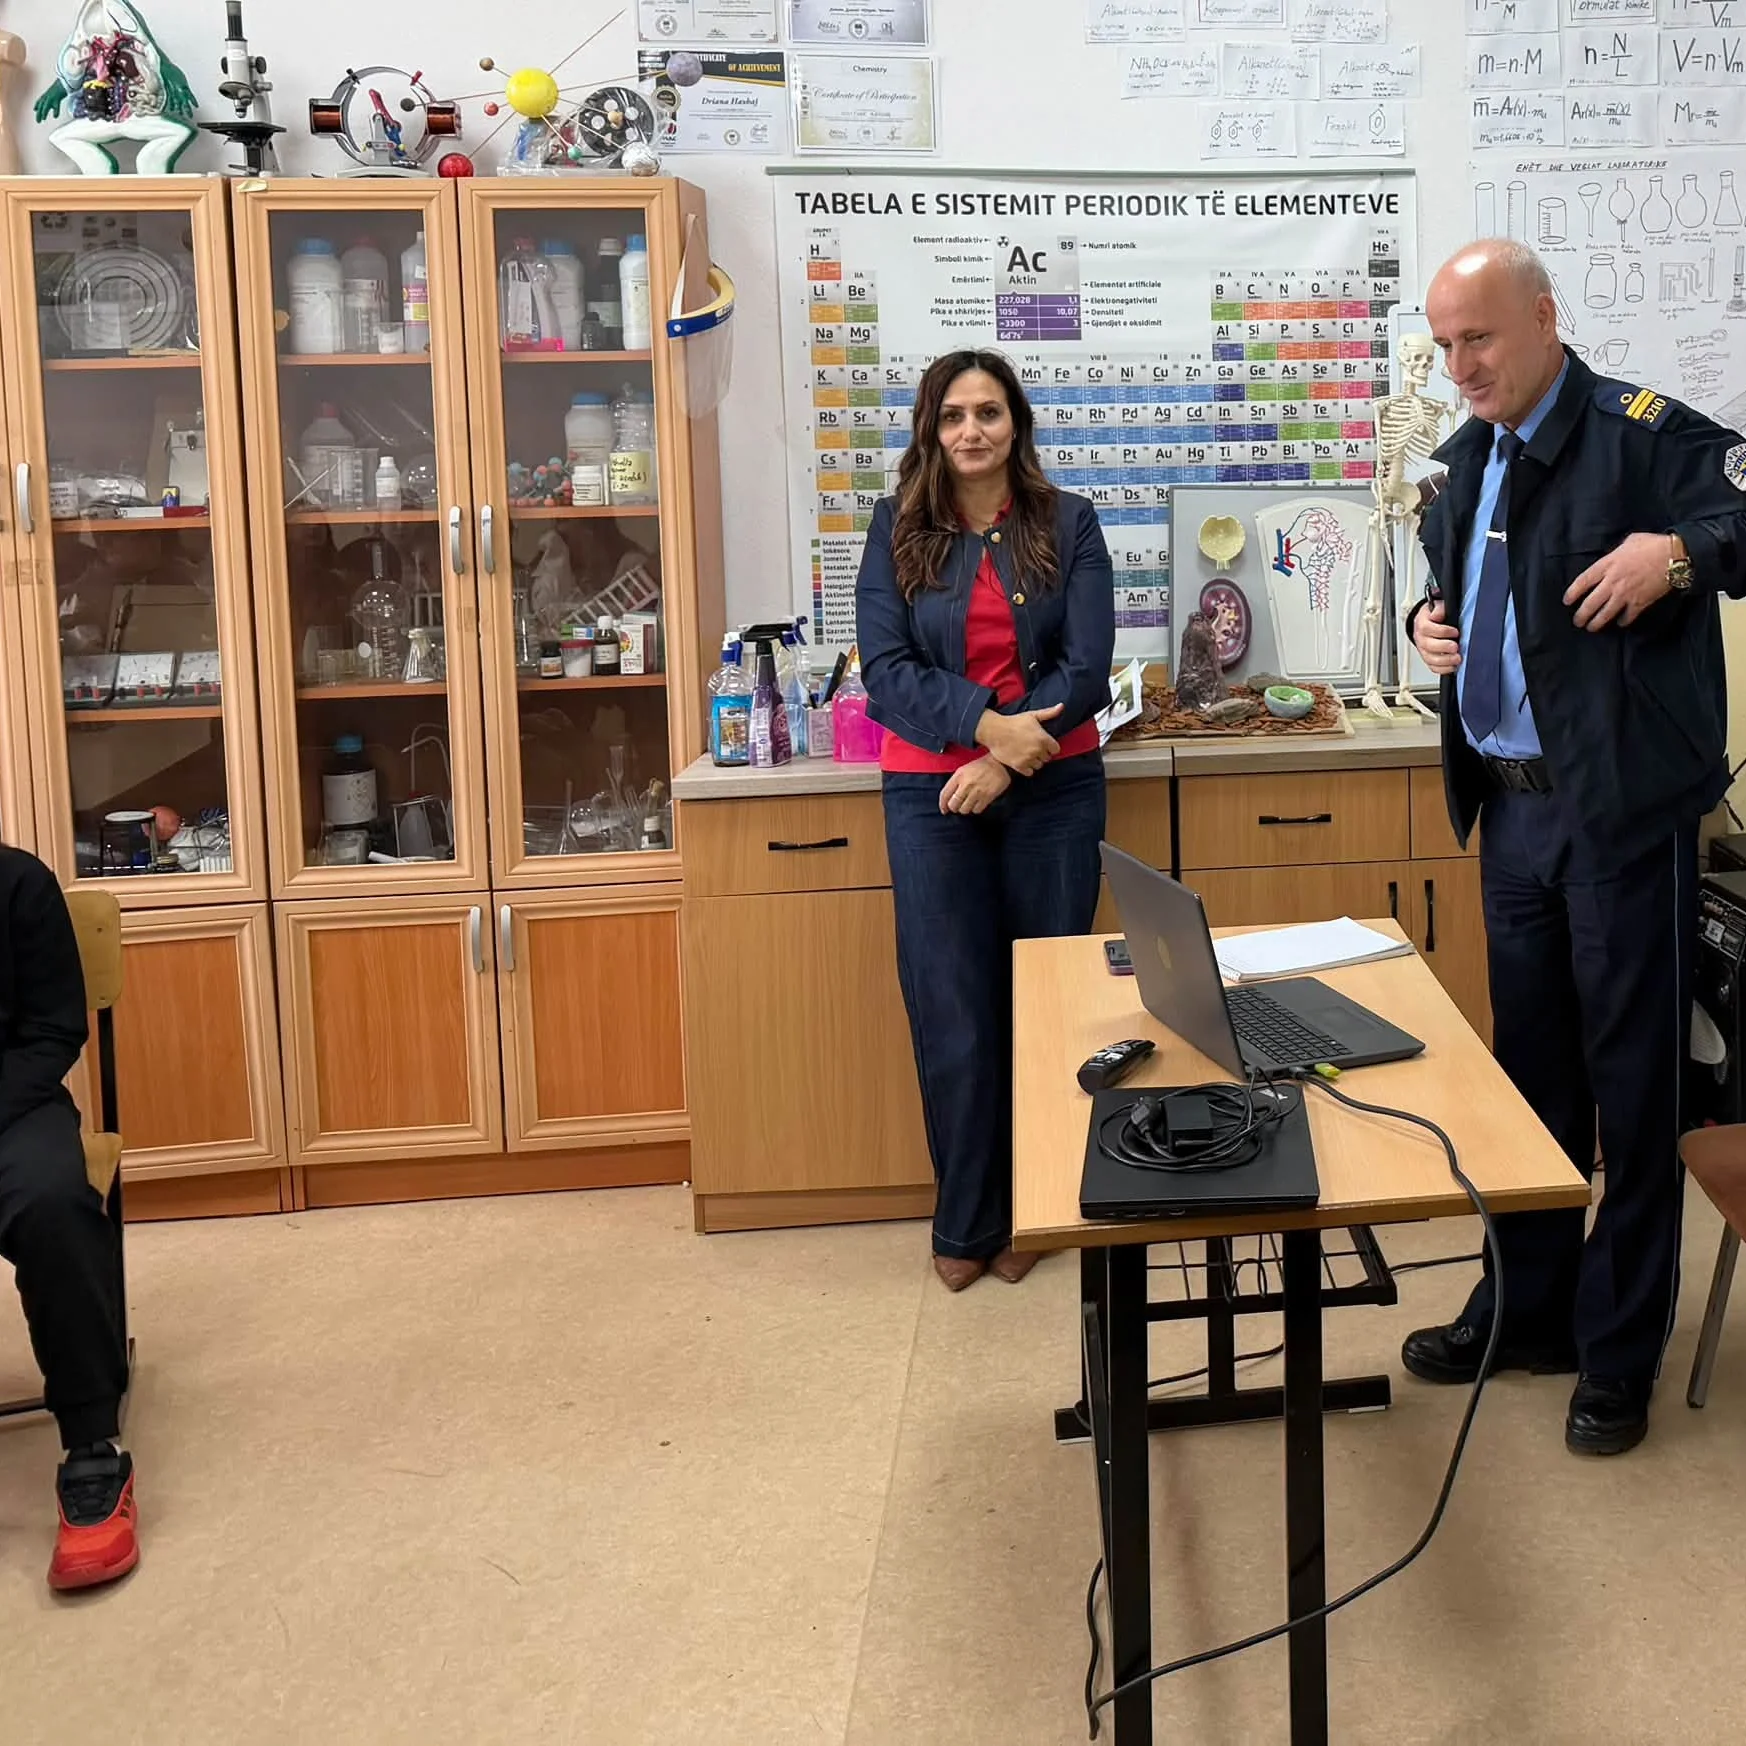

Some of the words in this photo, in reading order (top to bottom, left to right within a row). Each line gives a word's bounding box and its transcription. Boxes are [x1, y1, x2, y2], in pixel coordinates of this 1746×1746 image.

[852, 64, 888, 74] Chemistry
[795, 192, 904, 215] TABELA
[911, 193, 926, 215] E
[936, 194, 1057, 216] SISTEMIT
[1065, 194, 1189, 216] PERIODIK
[1196, 189, 1227, 216] TË
[1235, 193, 1400, 215] ELEMENTEVE
[913, 236, 944, 244] Element
[945, 236, 984, 244] radioaktiv
[1060, 241, 1074, 250] 89
[810, 244, 821, 256] H
[1372, 241, 1390, 252] He
[934, 255, 962, 263] Simboli
[963, 255, 984, 263] kimik
[1006, 246, 1047, 273] Ac
[951, 276, 986, 284] Emërtimi
[1008, 275, 1037, 285] Aktin
[1127, 280, 1162, 288] artificiale
[813, 284, 825, 296] Li
[848, 285, 866, 296] Be
[1215, 284, 1224, 295] B
[1247, 284, 1256, 295] C
[1280, 284, 1289, 294] N
[1311, 282, 1321, 293] O
[1343, 282, 1350, 293] F
[1373, 282, 1390, 293] Ne
[934, 297, 954, 305] Masa
[955, 297, 985, 305] atomike
[999, 296, 1031, 304] 227,028
[1090, 297, 1158, 305] Elektronegativiteti
[930, 308, 947, 316] Pika
[954, 308, 986, 317] shkrirjes
[999, 308, 1019, 316] 1050
[1057, 307, 1078, 316] 10,07
[941, 320, 958, 328] Pika
[1091, 320, 1122, 328] Gjendjet
[1129, 319, 1162, 327] oksidimit
[1312, 323, 1320, 334] S
[1343, 323, 1354, 334] Cl
[1374, 323, 1388, 333] Ar
[815, 328, 835, 339] Na
[849, 327, 871, 341] Mg
[1216, 325, 1229, 336] Al
[1249, 324, 1260, 336] Si
[1281, 324, 1289, 335] P
[1087, 367, 1104, 378] Co
[1120, 367, 1134, 378] Ni
[1153, 366, 1169, 378] Cu
[1185, 366, 1202, 377] Zn
[1217, 366, 1234, 377] Ga
[1249, 365, 1266, 376] Ge
[1281, 364, 1298, 375] As
[1313, 364, 1328, 375] Se
[1344, 363, 1358, 374] Br
[1375, 362, 1389, 373] Kr
[817, 369, 827, 381] K
[851, 369, 869, 381] Ca
[886, 369, 902, 380] Sc
[1021, 368, 1042, 379] Mn
[1054, 368, 1071, 379] Fe
[1056, 408, 1074, 420] Ru
[1089, 408, 1106, 419] Rh
[1122, 408, 1139, 419] Pd
[1154, 407, 1172, 419] Ag
[1186, 406, 1203, 418] Cd
[1218, 406, 1231, 417] In
[1250, 405, 1266, 417] Sn
[1282, 405, 1298, 416] Sb
[1313, 404, 1328, 415] Te
[1344, 404, 1349, 414] I
[1642, 398, 1667, 423] 3210
[819, 411, 838, 423] Rb
[853, 411, 868, 423] Sr
[888, 411, 897, 422] Y
[1089, 449, 1100, 460] Ir
[1123, 448, 1138, 460] Pt
[1155, 448, 1173, 459] Au
[1187, 447, 1205, 461] Hg
[1251, 446, 1268, 457] Pb
[1283, 444, 1295, 456] Bi
[1314, 444, 1331, 455] Po
[1345, 443, 1360, 455] At
[820, 453, 837, 466] Cs
[855, 453, 873, 464] Ba
[1057, 449, 1074, 461] Os
[1092, 490, 1109, 501] Mt
[1124, 489, 1141, 500] Ds
[822, 496, 836, 507] Fr
[857, 495, 875, 506] Ra
[1126, 551, 1142, 562] Eu
[1158, 551, 1170, 561] G
[1126, 592, 1148, 603] Am
[1159, 591, 1170, 602] C
